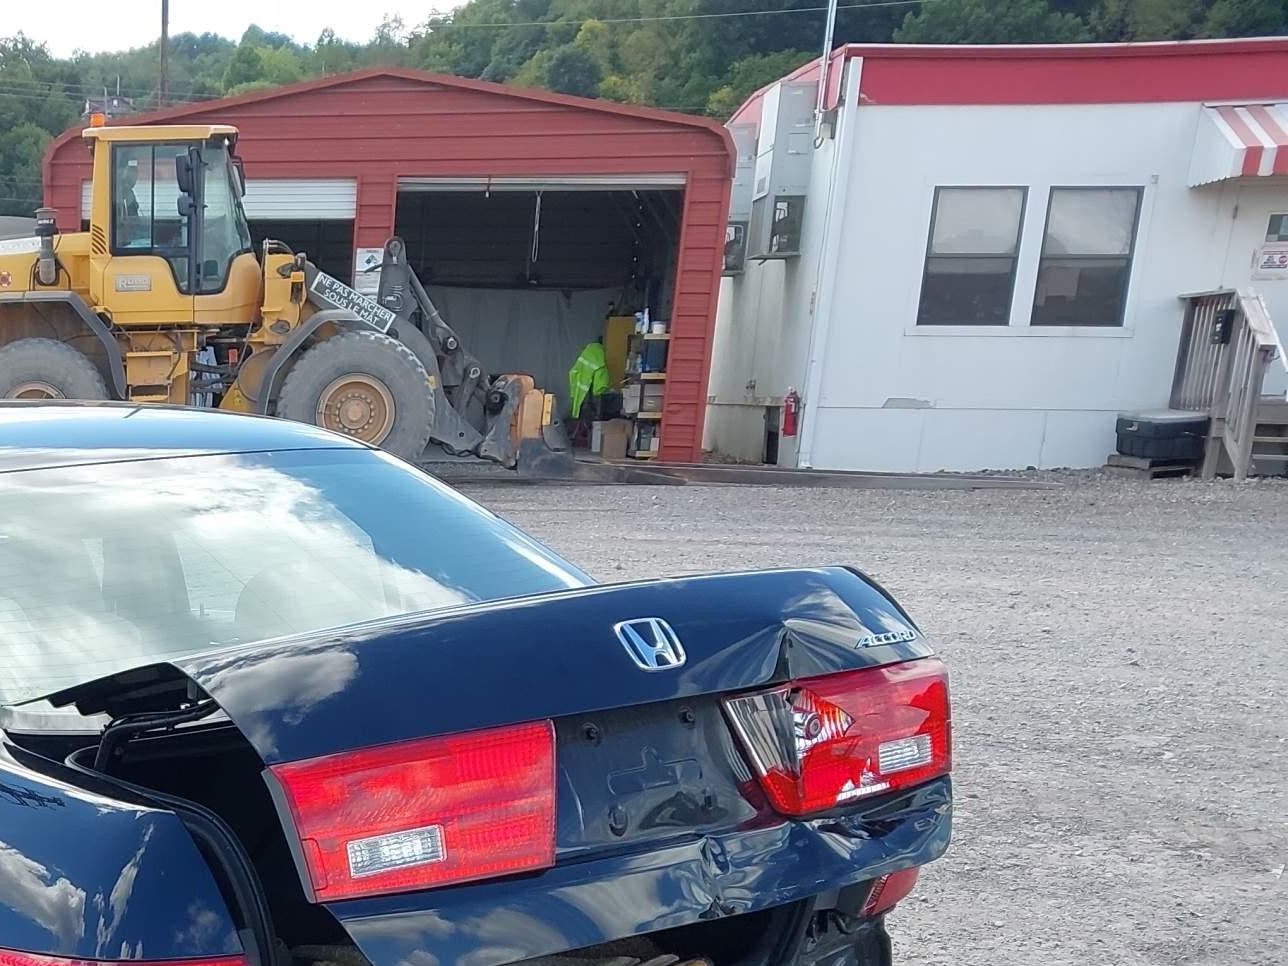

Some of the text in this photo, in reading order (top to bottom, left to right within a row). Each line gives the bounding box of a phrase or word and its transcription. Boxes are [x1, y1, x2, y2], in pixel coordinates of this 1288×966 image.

[319, 274, 392, 321] NE PAS MARCHER
[324, 288, 348, 308] SOUS
[347, 303, 361, 315] LE
[856, 630, 917, 649] ACCORD
